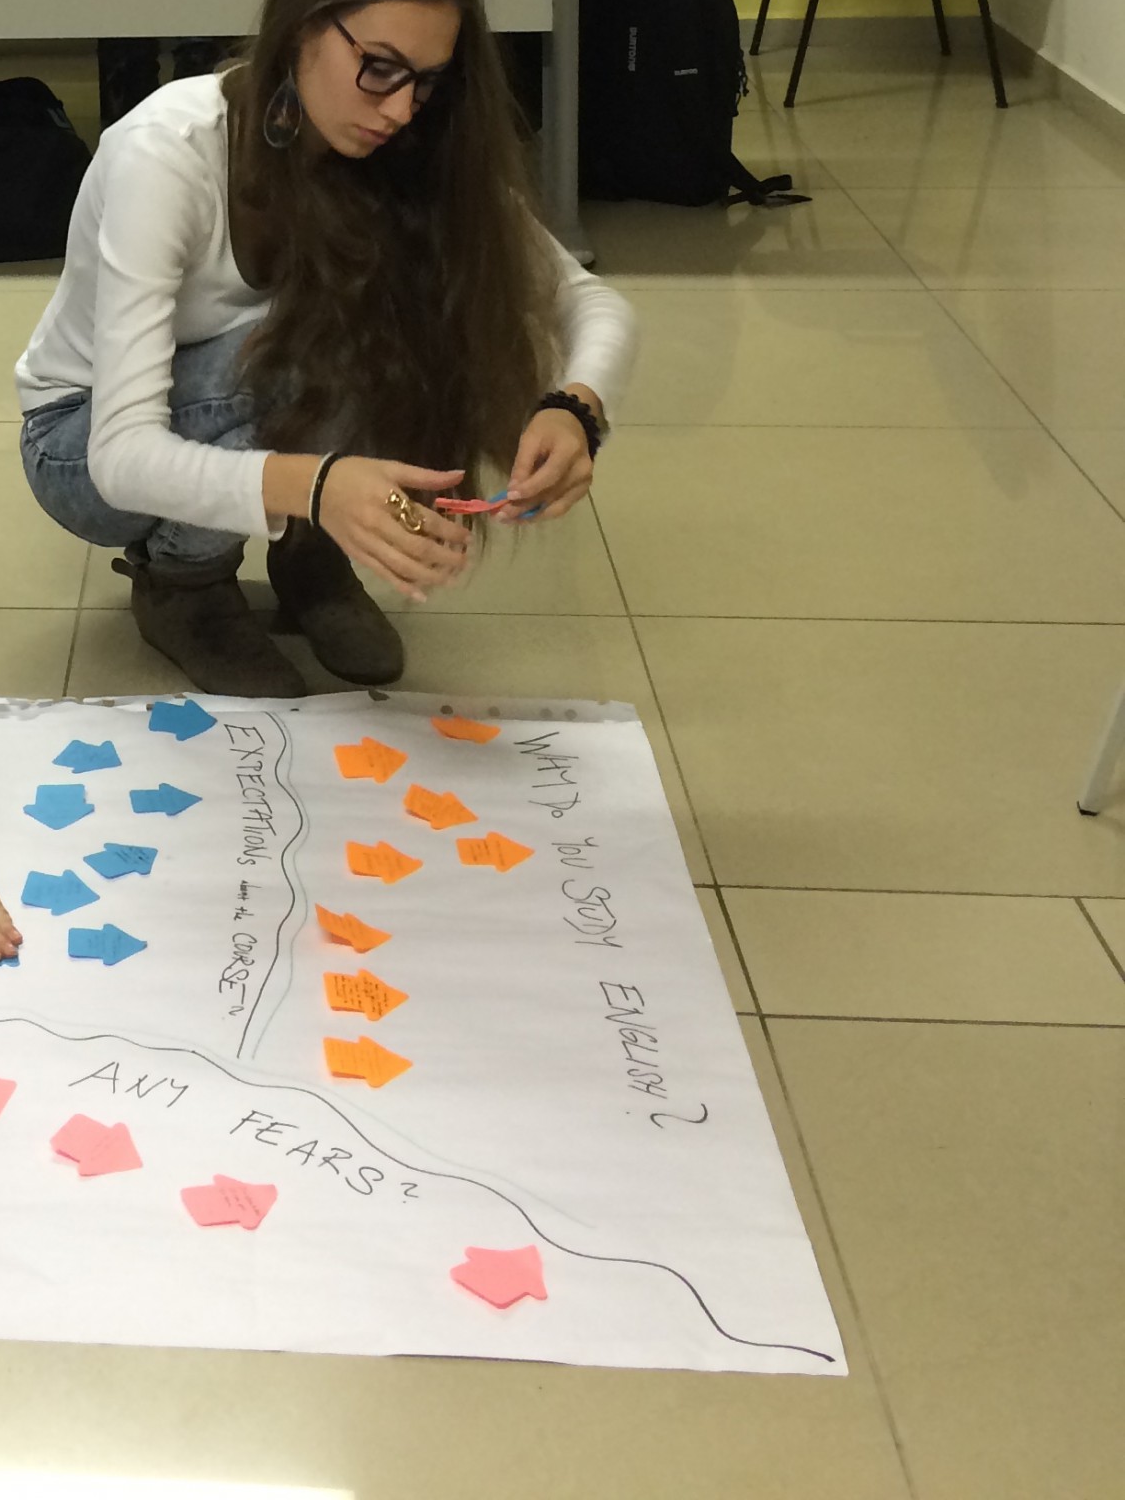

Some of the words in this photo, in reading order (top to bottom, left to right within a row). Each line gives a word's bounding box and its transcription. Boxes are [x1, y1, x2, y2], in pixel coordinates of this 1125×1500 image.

[513, 731, 579, 788] WHY
[551, 837, 599, 869] YOU
[233, 906, 255, 921] the
[562, 879, 623, 948] STUDY
[68, 1061, 189, 1108] ANY
